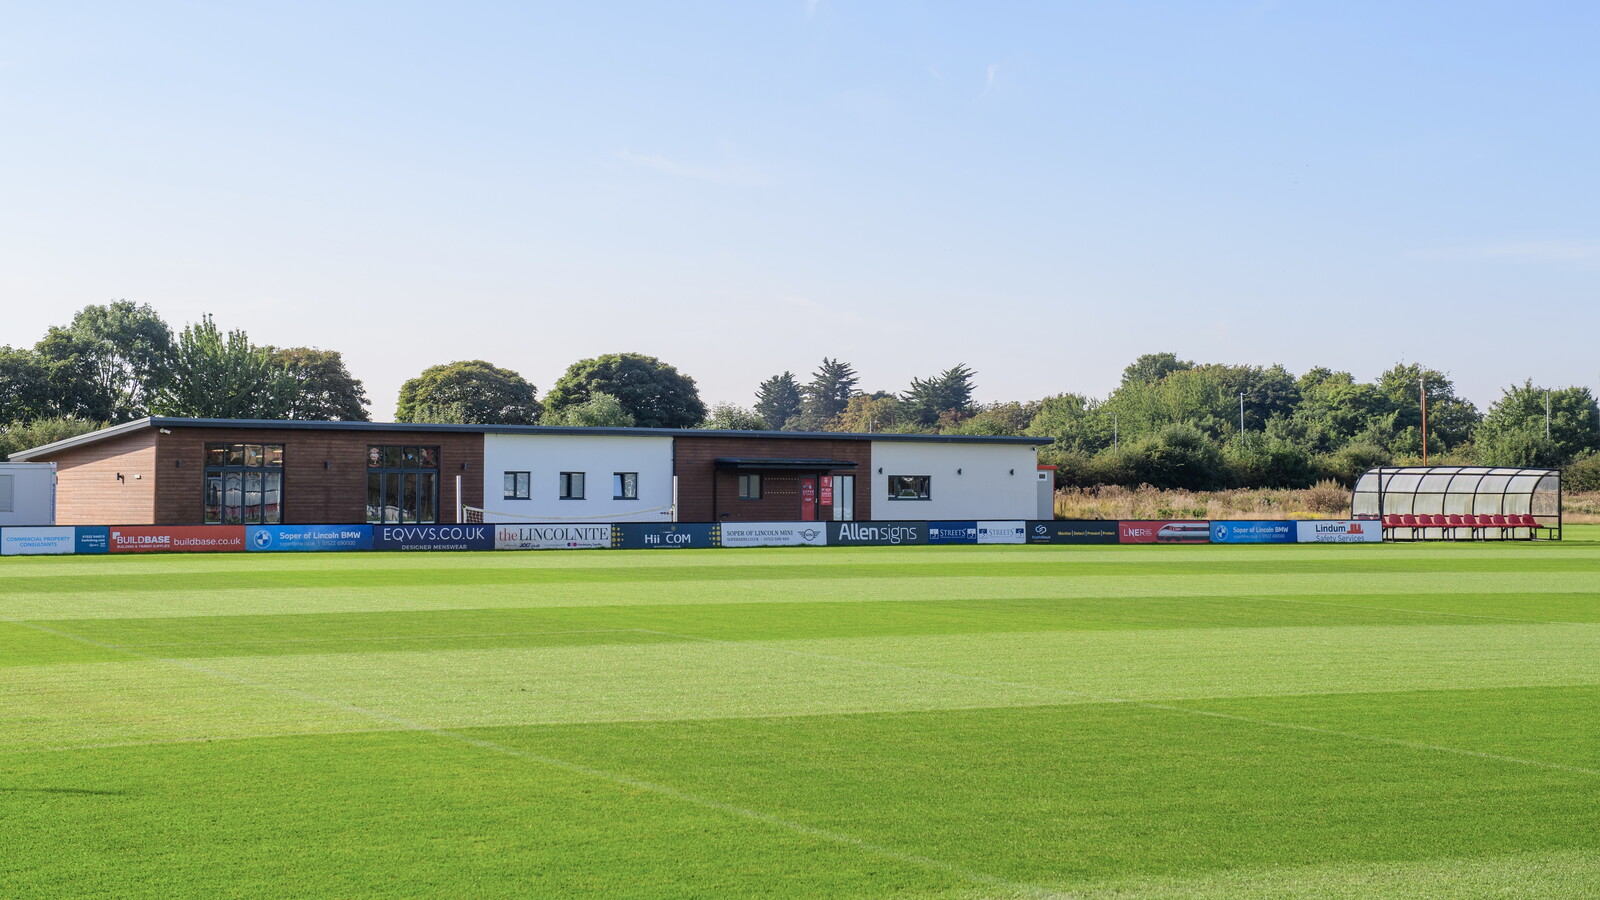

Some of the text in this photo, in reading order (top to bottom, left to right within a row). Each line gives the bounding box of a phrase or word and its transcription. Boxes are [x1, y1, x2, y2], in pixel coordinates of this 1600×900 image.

[280, 532, 301, 540] Soper
[383, 528, 485, 542] EQVVS.CO.UK
[838, 523, 917, 544] Allen signs
[940, 528, 966, 536] STREETS
[644, 534, 691, 543] Hii COM
